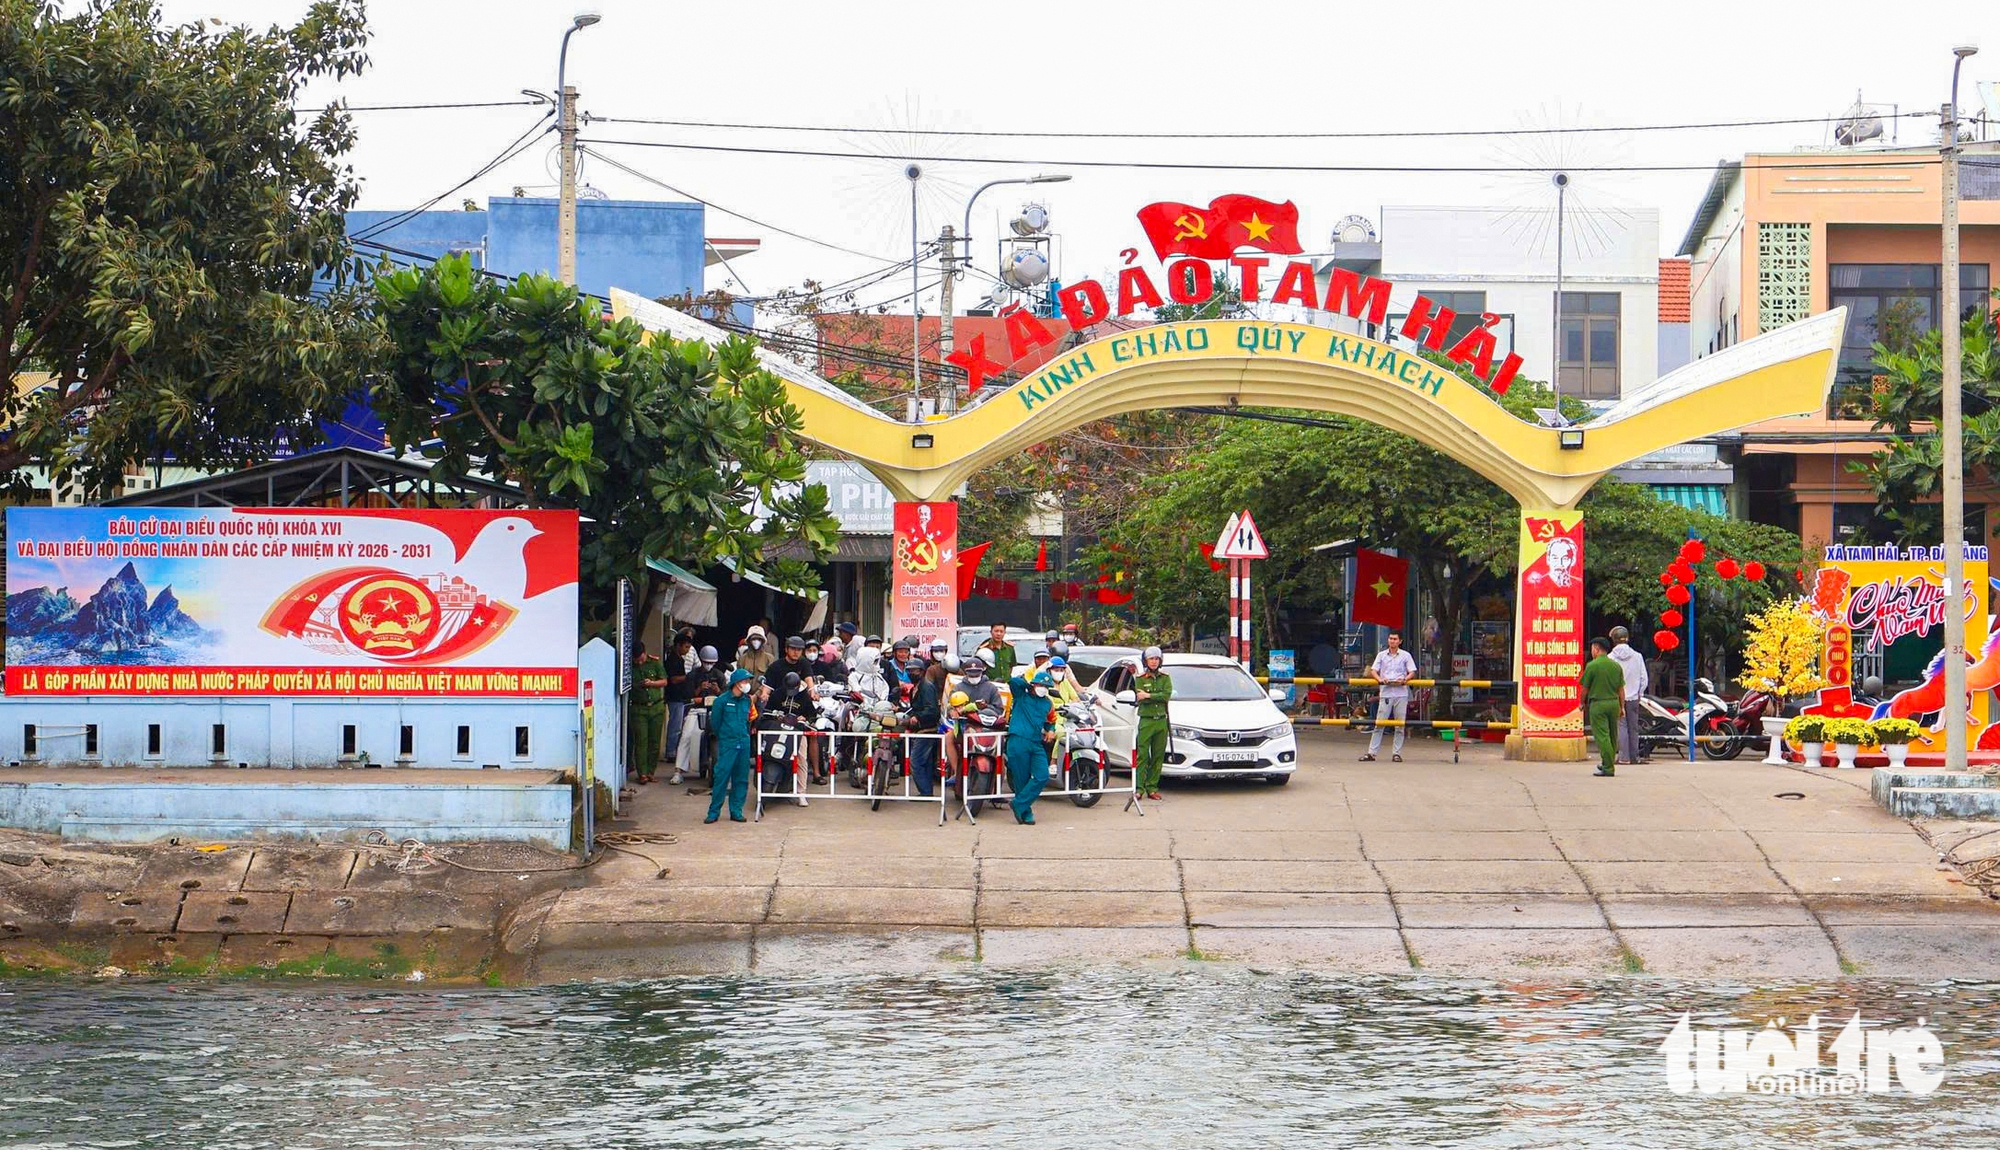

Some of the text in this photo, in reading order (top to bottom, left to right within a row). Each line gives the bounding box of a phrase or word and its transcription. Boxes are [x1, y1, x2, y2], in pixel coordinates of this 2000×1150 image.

[945, 247, 1524, 396] XÃ ĐẢO TAM HẢI
[1111, 325, 1209, 362] CHÀO
[1326, 335, 1445, 397] KHÁCH
[818, 464, 860, 478] TẠP HÓA
[139, 516, 160, 536] CỬ
[160, 521, 182, 539] ĐẠI
[186, 516, 215, 536] BIỂU
[219, 516, 253, 536] QUỐC
[257, 518, 279, 539] HỘI
[283, 518, 317, 536] KHÓA
[321, 521, 342, 536] XVI
[18, 540, 36, 557] VÀ
[38, 543, 60, 560] ĐẠI
[64, 537, 93, 557] BIỂU
[97, 541, 119, 560] HỘI
[122, 537, 158, 557] ĐỒNG
[161, 541, 199, 557] NHÂN
[202, 541, 229, 557] DÂN
[232, 540, 259, 557] CÁC
[262, 538, 288, 557] CẤP
[291, 541, 334, 560] NHIỆM
[337, 540, 354, 558] KỲ
[358, 544, 389, 558] 2026
[401, 544, 431, 558] 2031
[1826, 543, 1844, 560] XÃ
[1846, 547, 1872, 560] TAM
[1876, 543, 1899, 560] HẢI
[1910, 547, 1928, 561] TP.
[901, 581, 949, 597] ĐẢNG CỘNG SẢN
[911, 600, 939, 612] VIỆT NAM
[1538, 593, 1568, 613] CHỦ TỊCH
[1846, 574, 1912, 630] Chúc
[900, 614, 919, 628] NGƯỜI
[1543, 617, 1555, 633] CHÍ
[1555, 618, 1574, 633] MINH
[1534, 641, 1546, 658] ĐẠI
[1546, 637, 1566, 656] SỐNG
[1566, 639, 1580, 656] MÃI
[1524, 661, 1582, 680] TRONG SỰ NGHIỆP
[23, 671, 38, 690] LÀ
[45, 671, 69, 690] GÓP
[72, 668, 106, 690] PHẦN
[109, 671, 132, 690] XÂY
[136, 671, 170, 693] DỰNG
[173, 669, 198, 690] NHÀ
[201, 669, 234, 690] NƯỚC
[237, 669, 270, 690] PHÁP
[315, 670, 333, 690] XÃ
[335, 671, 356, 694] HỘI
[359, 669, 383, 690] CHỦ
[386, 670, 424, 690] NGHĨA
[426, 671, 452, 694] VIỆT
[455, 674, 483, 690] NAM
[486, 671, 519, 690] VỮNG
[522, 673, 562, 694] MẠNH!
[1528, 682, 1577, 700] CỦA CHÚNG TA!
